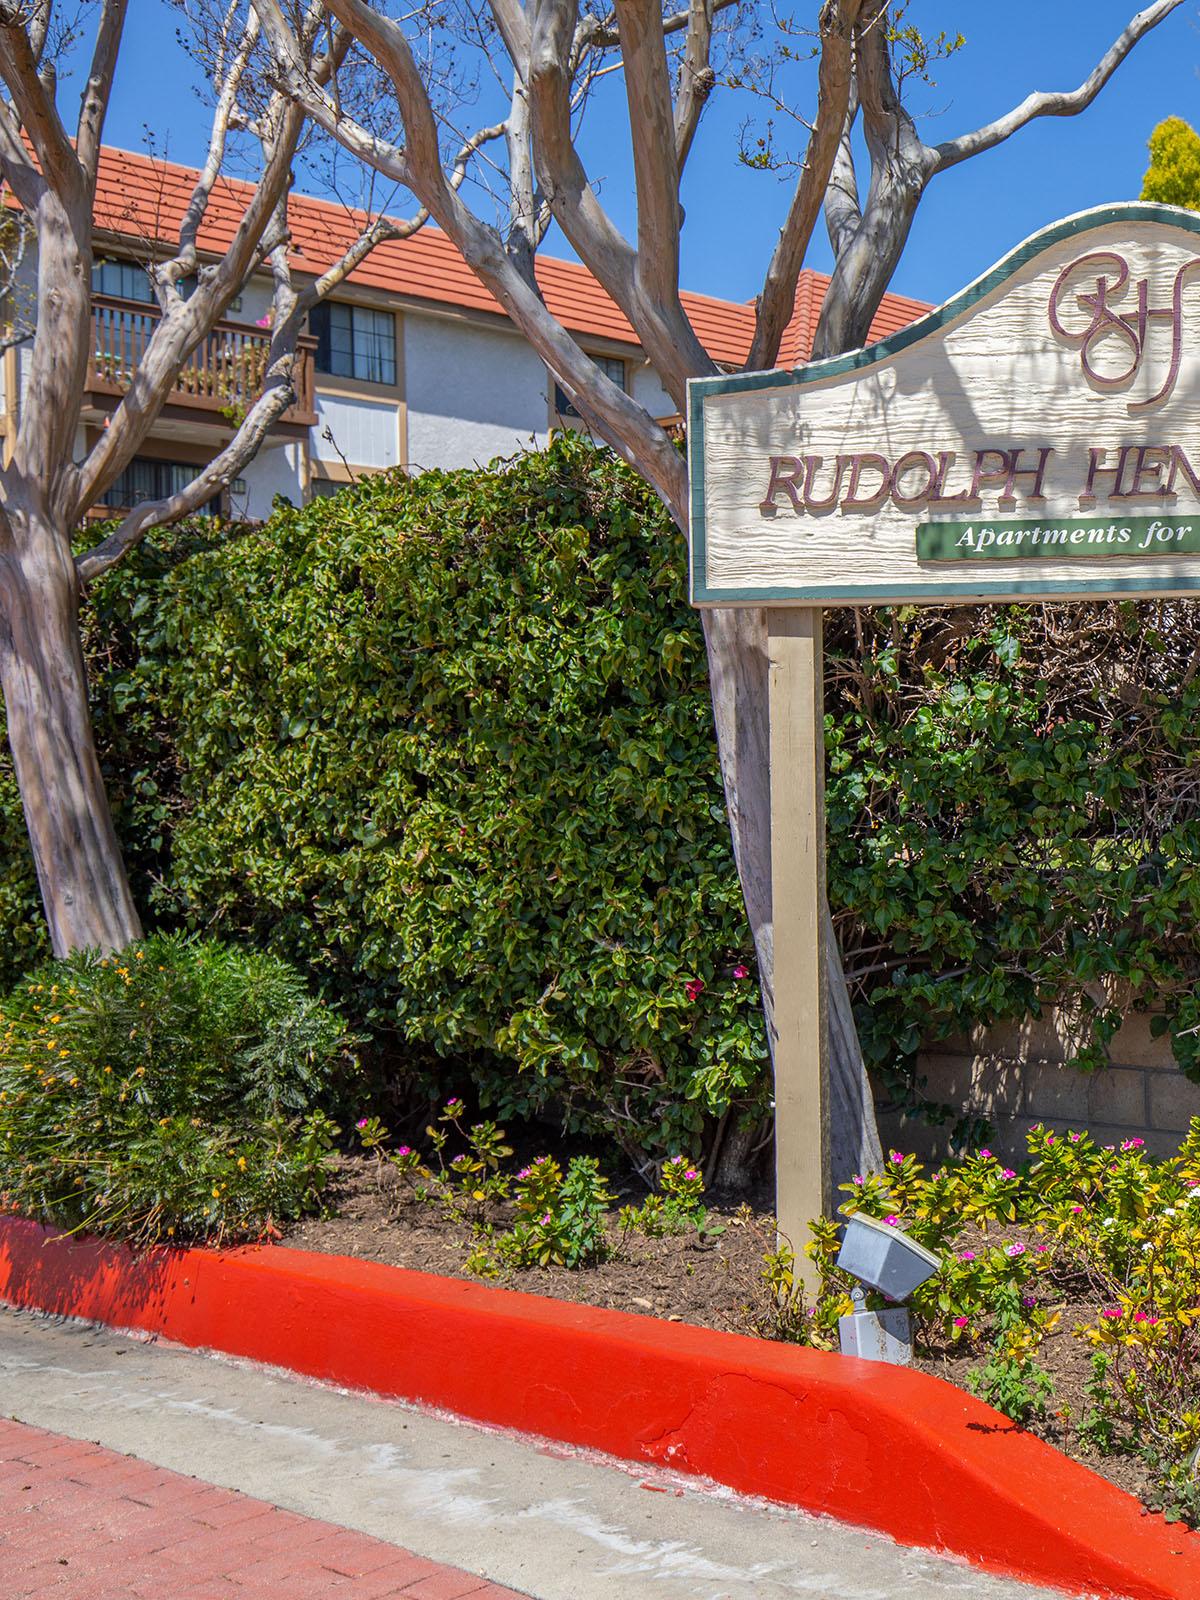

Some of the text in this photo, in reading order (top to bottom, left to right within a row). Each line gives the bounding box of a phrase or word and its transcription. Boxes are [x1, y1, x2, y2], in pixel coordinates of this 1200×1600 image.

[759, 448, 1056, 510] RUDOLPH
[955, 525, 1132, 552] Apartments
[1138, 521, 1192, 548] for
